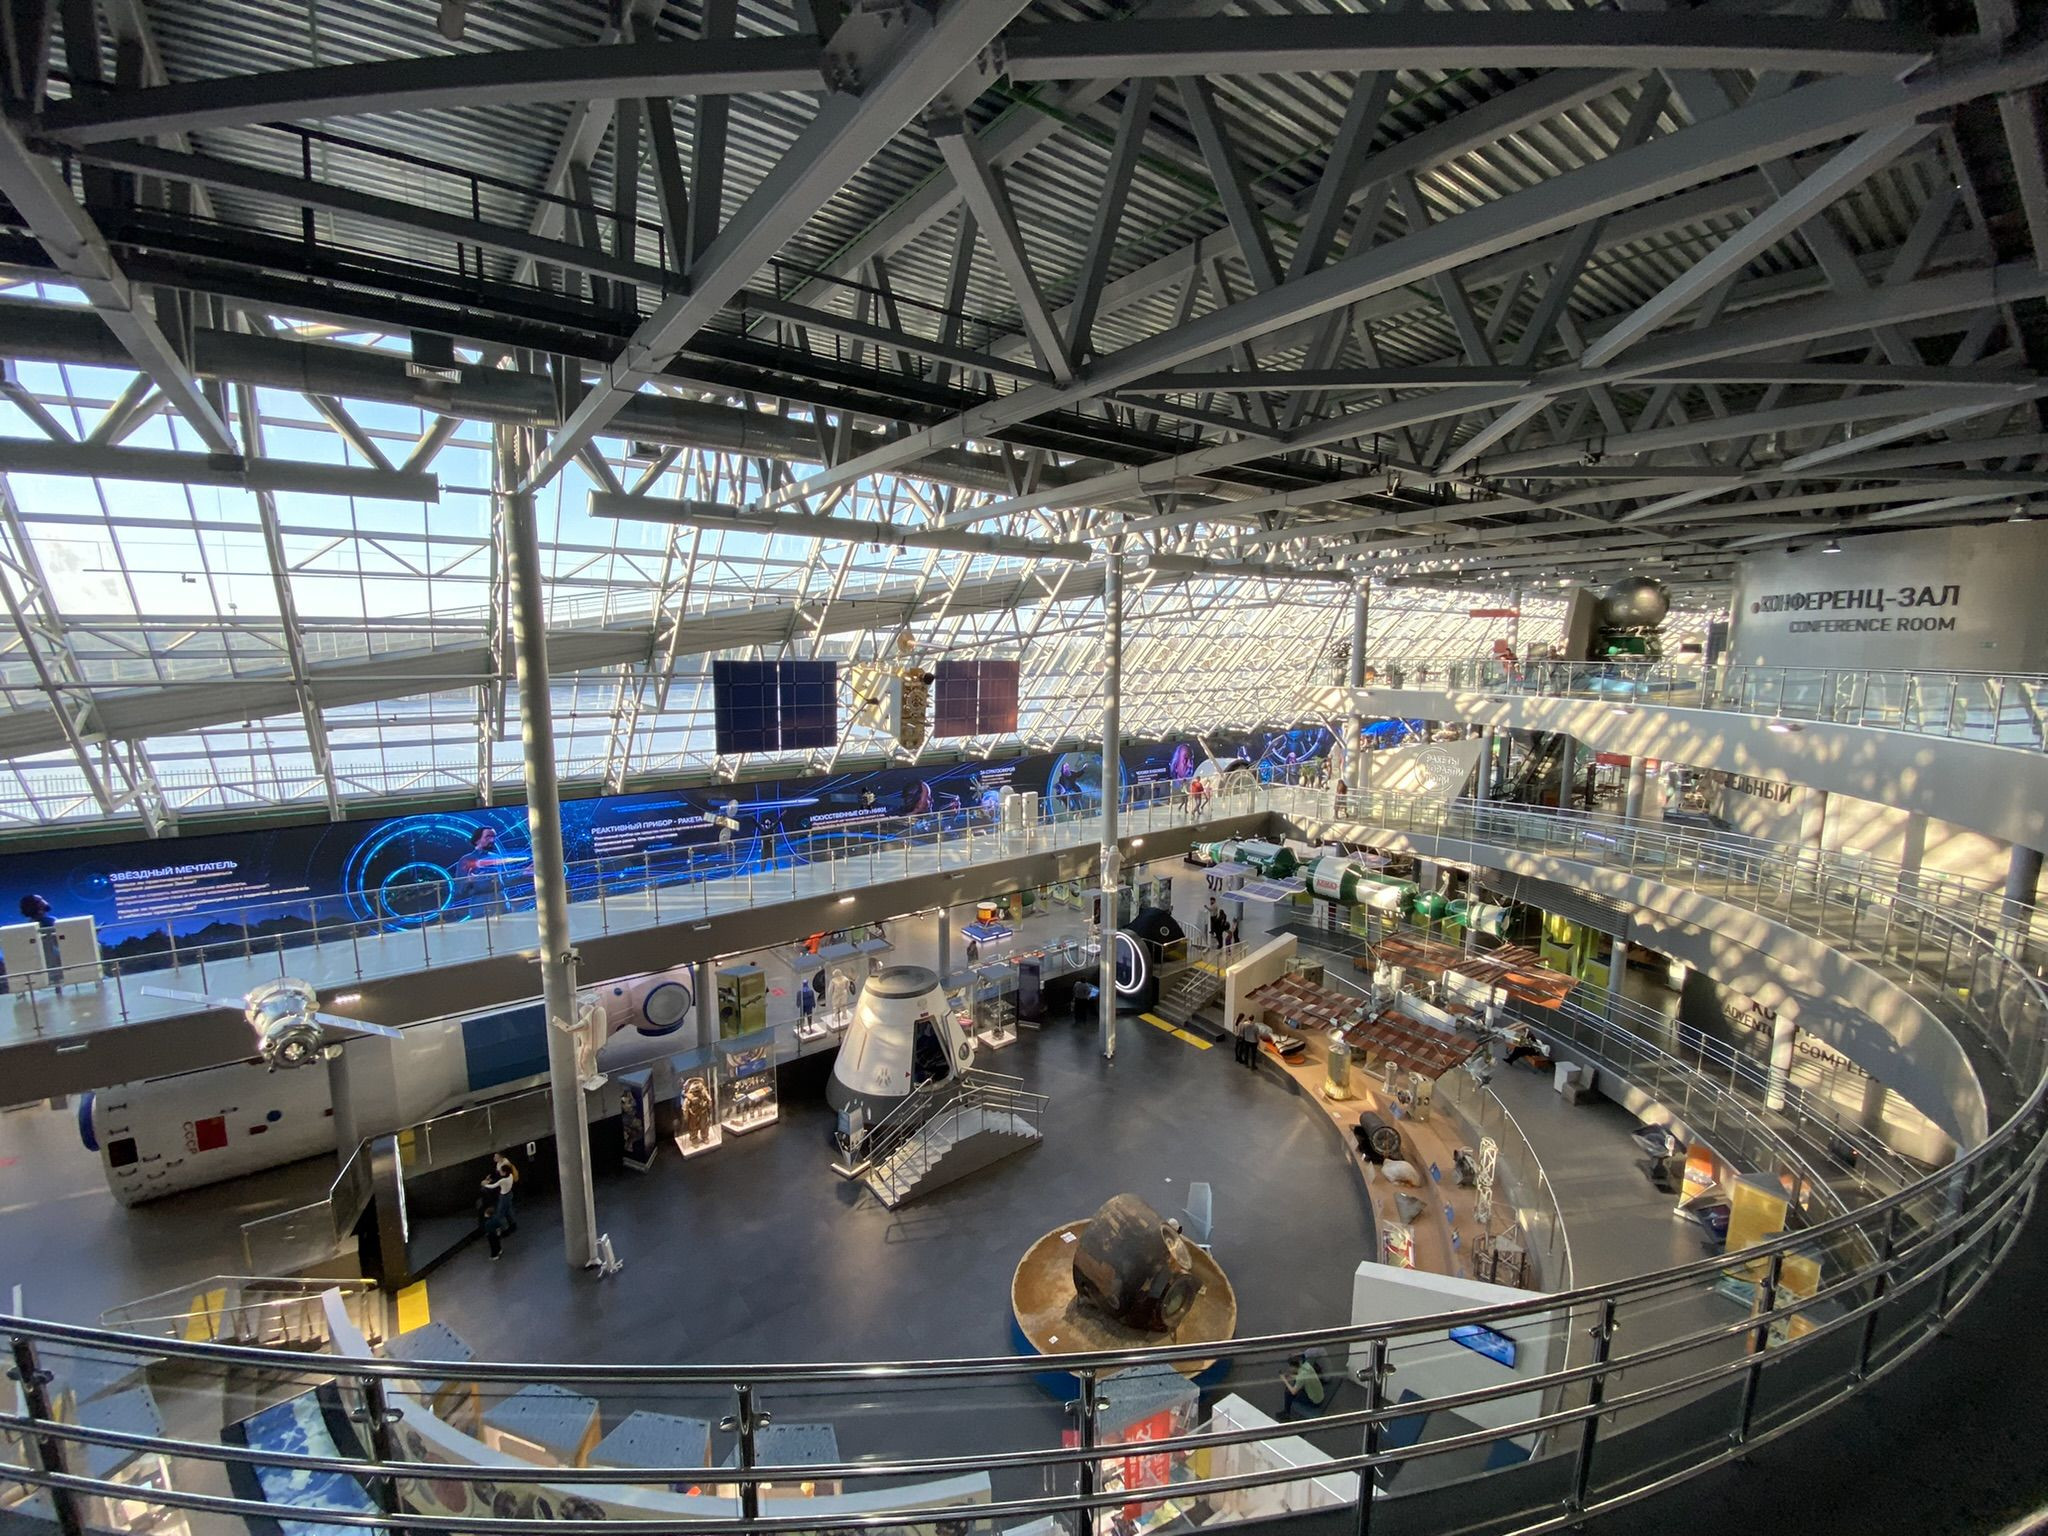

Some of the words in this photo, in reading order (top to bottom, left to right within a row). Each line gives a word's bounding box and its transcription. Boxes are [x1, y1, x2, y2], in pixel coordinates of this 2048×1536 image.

[1759, 585, 1961, 613] КОНФЕРЕНЦ-ЗАЛ
[1789, 618, 1891, 633] CONFERENCE
[1896, 616, 1956, 631] ROOM
[591, 821, 642, 834] РЕАКТИВНЫЙ
[643, 819, 673, 829] ПРИБОР
[678, 815, 703, 825] РАКЕТА
[175, 860, 238, 874] МЕЧТАТЕЛЬ
[1800, 1041, 1880, 1083] COMPLE
[183, 1121, 198, 1155] СССР
